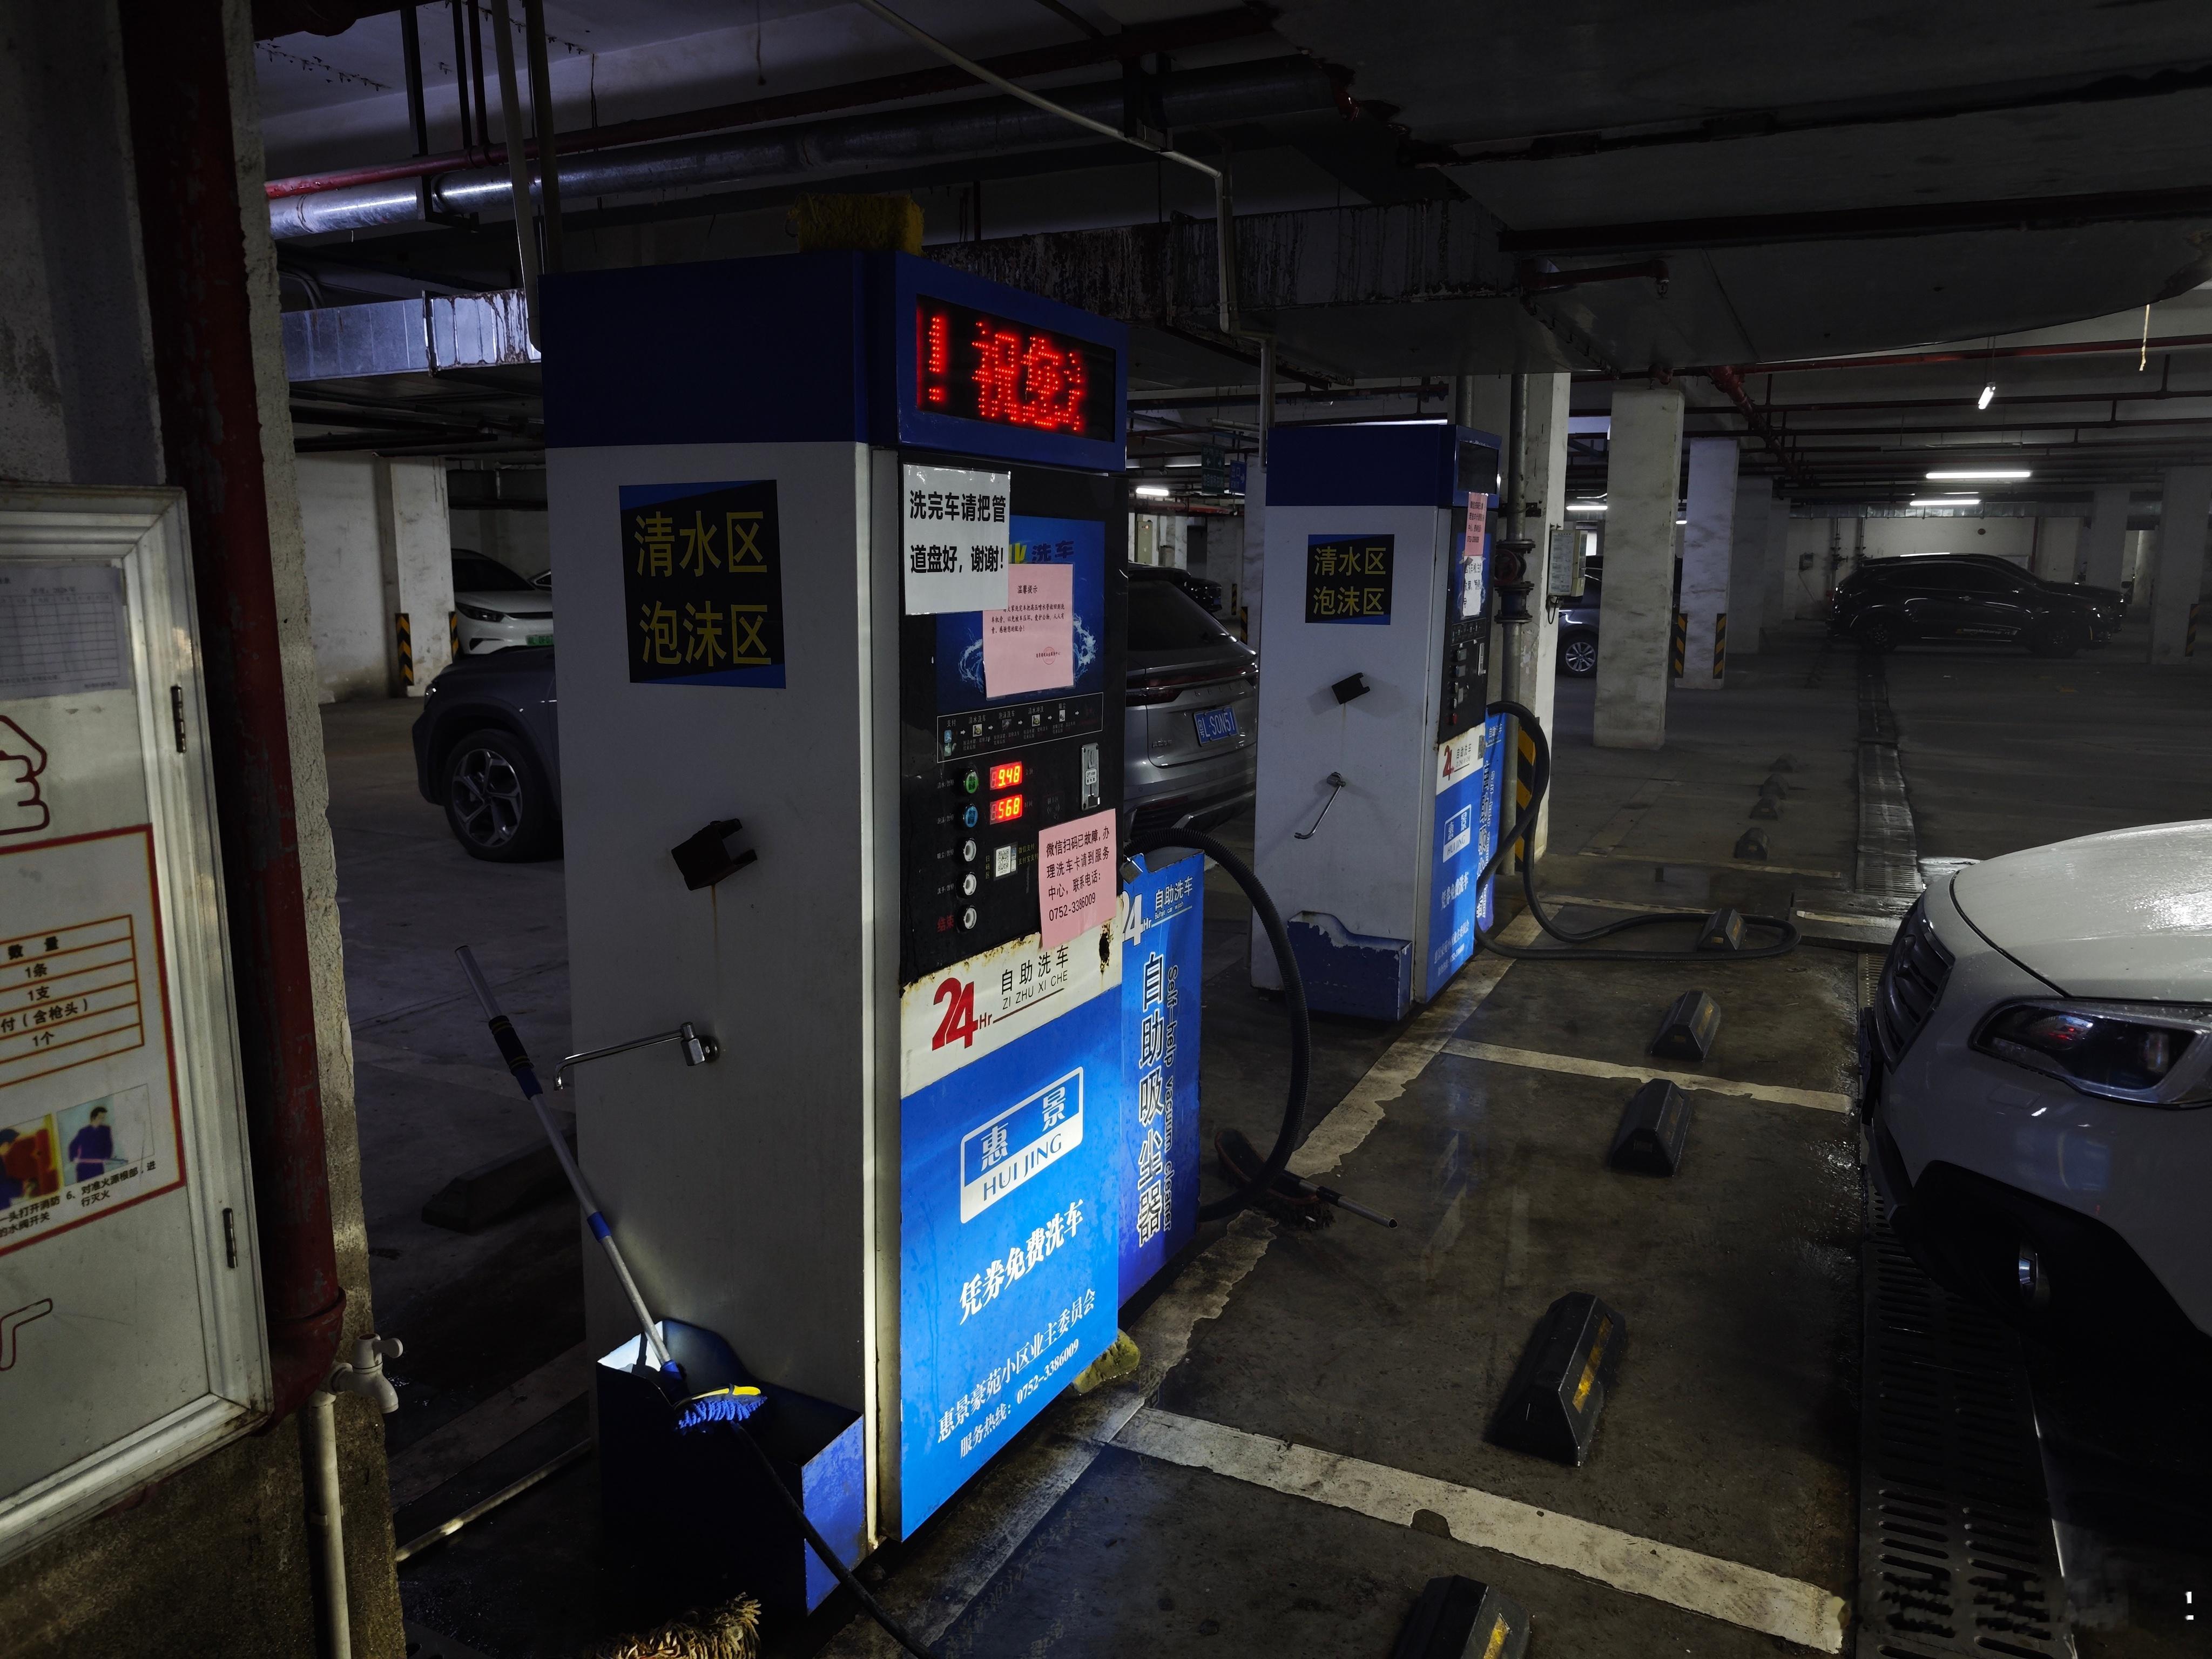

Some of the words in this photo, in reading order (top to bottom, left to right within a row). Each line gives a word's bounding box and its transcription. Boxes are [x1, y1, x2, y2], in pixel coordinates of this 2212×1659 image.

[909, 490, 1007, 523] 洗完车请把管
[633, 510, 768, 577] 清水区
[1313, 545, 1387, 576] 清水区
[1017, 585, 1038, 594] 温馨提示
[1313, 585, 1385, 616] 泡沫区
[639, 600, 772, 667] 泡沫区
[998, 797, 1021, 819] 568
[1046, 825, 1110, 857] 微信扫码已故障，办
[1047, 847, 1110, 879] 理洗车卡请到服务
[1048, 872, 1101, 901] 中心，联系电话：
[1155, 875, 1193, 912] 自助洗车
[1049, 892, 1096, 921] 0752-3386009
[25, 963, 48, 979] 1条
[1001, 945, 1069, 995] 自助洗车
[28, 986, 50, 1001] 1支
[1003, 997, 1011, 1010] ZI
[1016, 986, 1034, 1003] ZHU
[1038, 981, 1047, 992] XI
[1050, 970, 1068, 985] CHE
[32, 1031, 55, 1047] 1个
[1136, 951, 1165, 1248] 自助吸尘器
[1164, 1075, 1174, 1154] vacuum
[980, 1086, 1067, 1172] 惠景
[983, 1162, 1017, 1202] HUI
[1024, 1132, 1062, 1178] JING
[80, 1190, 110, 1208] 行灭火
[1163, 1161, 1175, 1232] cleaner
[959, 1198, 1084, 1326] 凭券免费洗车
[938, 1288, 1096, 1444] 惠景豪苑小区业主委员会
[959, 1402, 1012, 1460] 服务热线：
[1016, 1338, 1080, 1405] 0752-3386009
